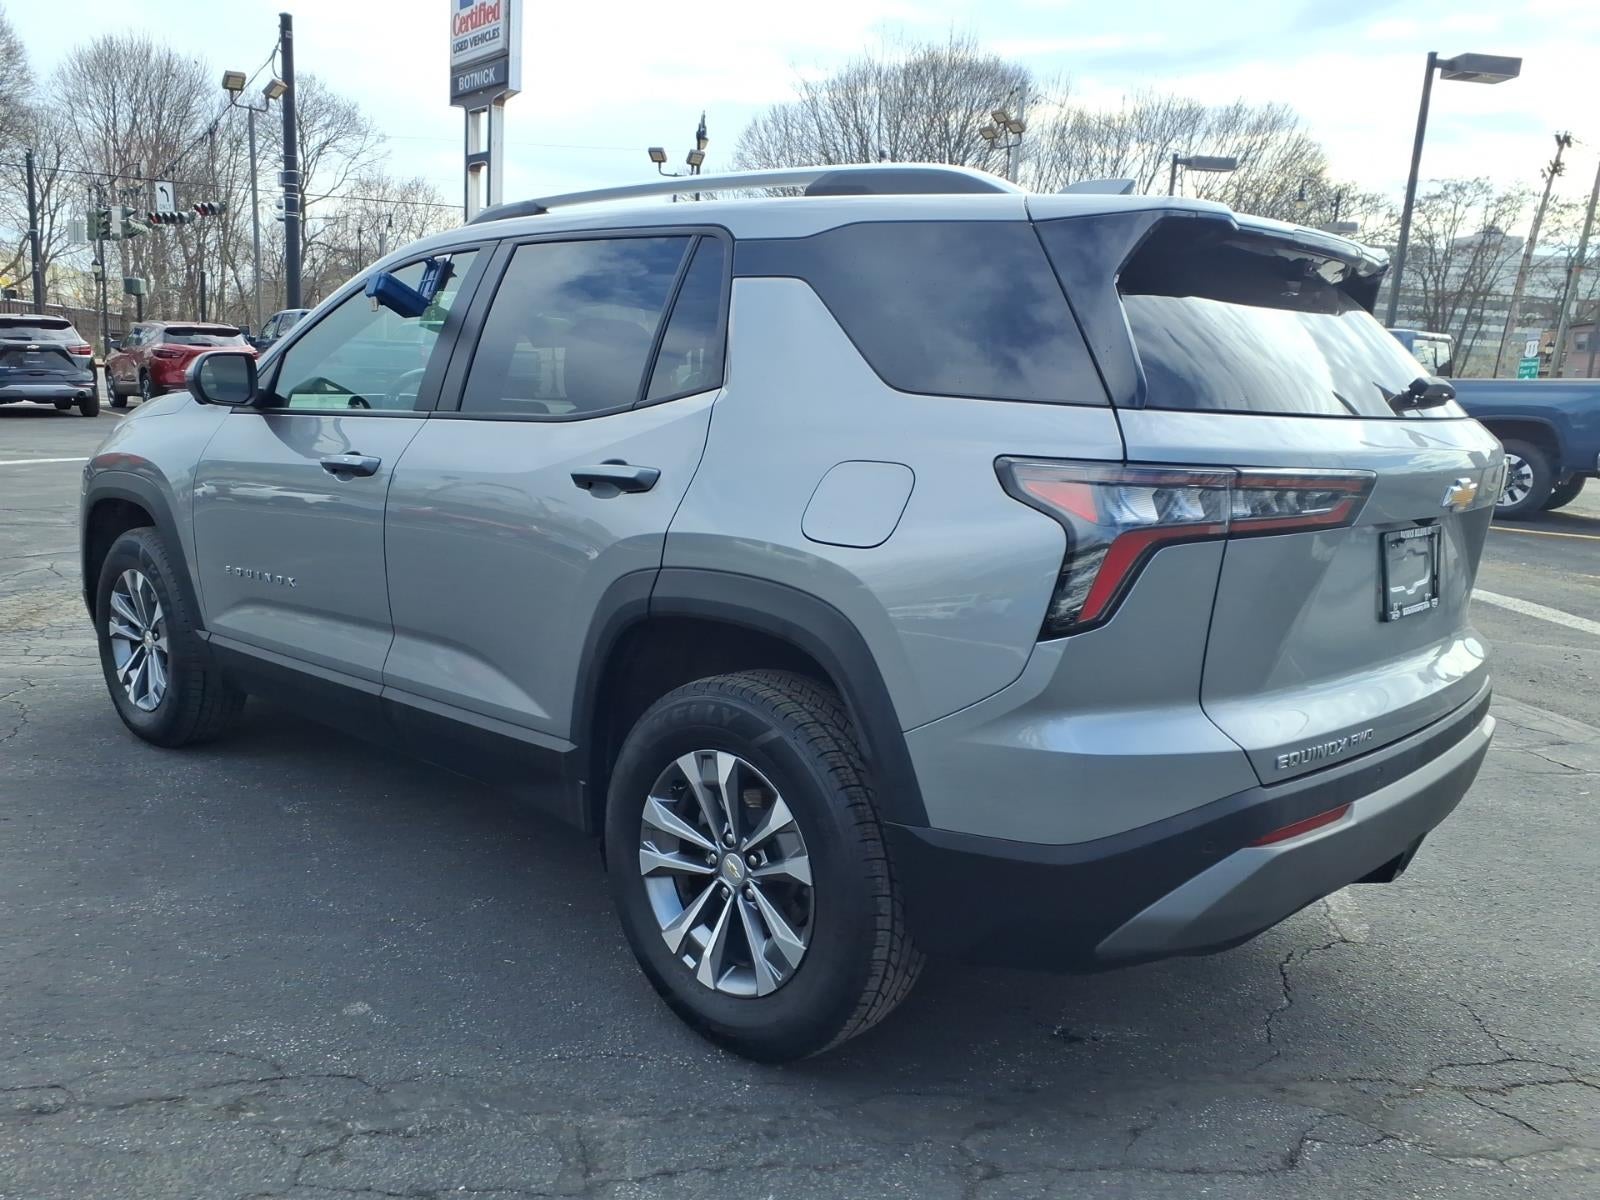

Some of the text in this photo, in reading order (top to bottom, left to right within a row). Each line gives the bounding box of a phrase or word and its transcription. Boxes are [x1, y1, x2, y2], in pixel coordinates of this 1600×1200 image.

[453, 0, 500, 36] Certified
[453, 27, 500, 54] USED VEHICLES
[458, 67, 496, 91] BOTNICK
[225, 565, 296, 587] EQUINOX
[1277, 737, 1348, 769] EQUINOX
